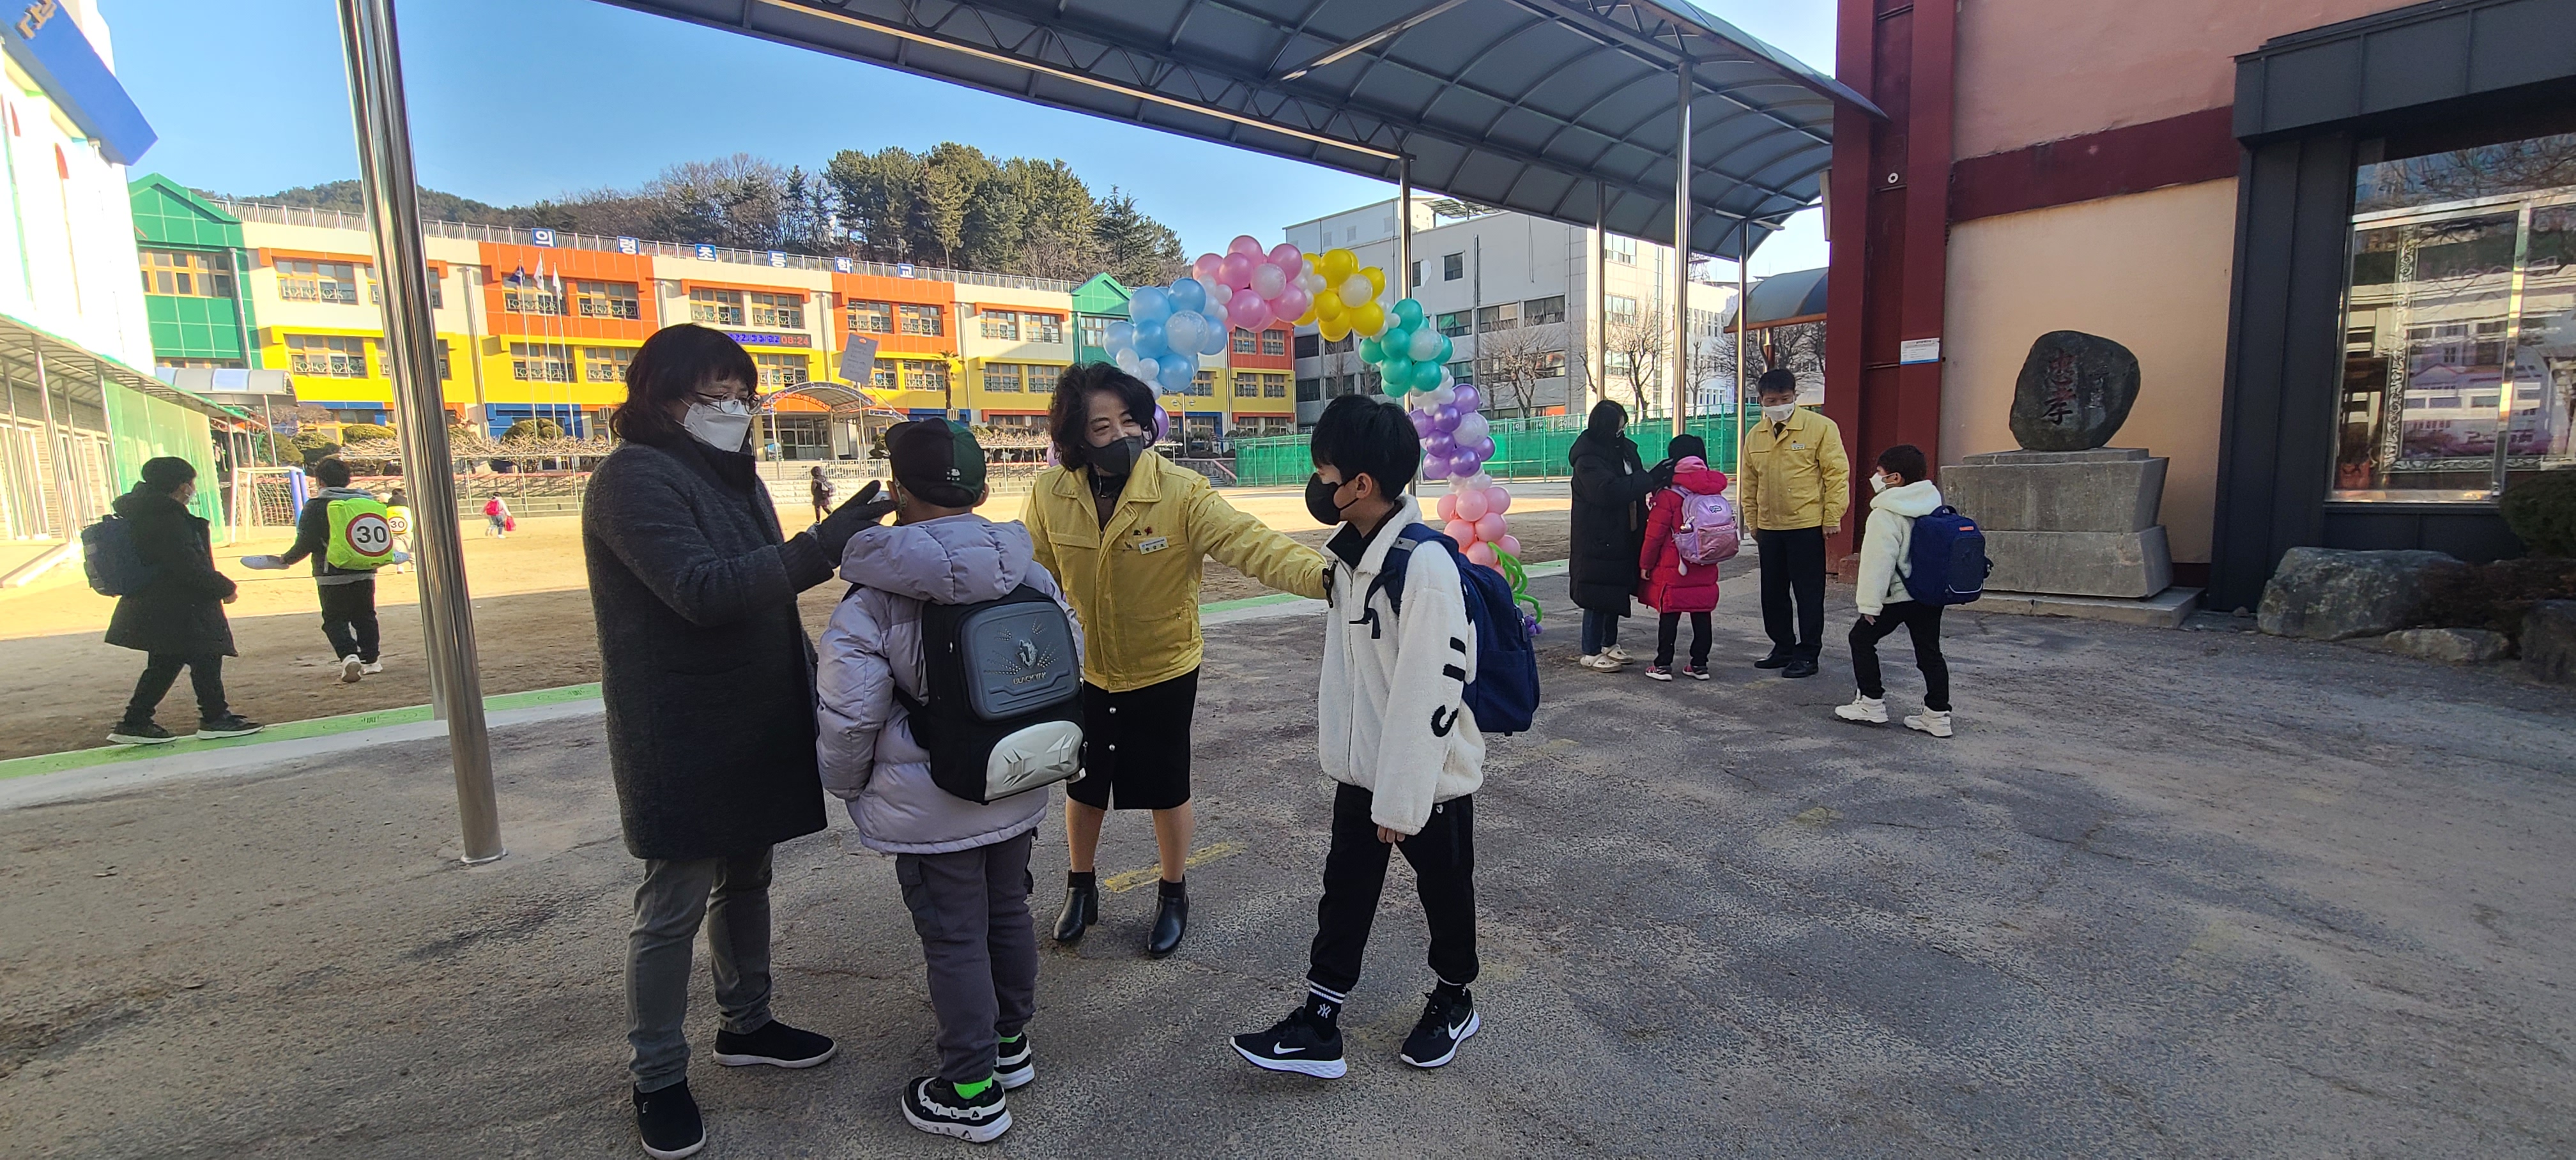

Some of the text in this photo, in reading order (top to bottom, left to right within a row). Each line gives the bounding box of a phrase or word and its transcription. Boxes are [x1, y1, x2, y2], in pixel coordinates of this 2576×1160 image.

[535, 231, 914, 279] 의령초등학교
[781, 335, 809, 345] 08:24
[356, 526, 387, 543] 30
[1317, 1004, 1331, 1019] NY
